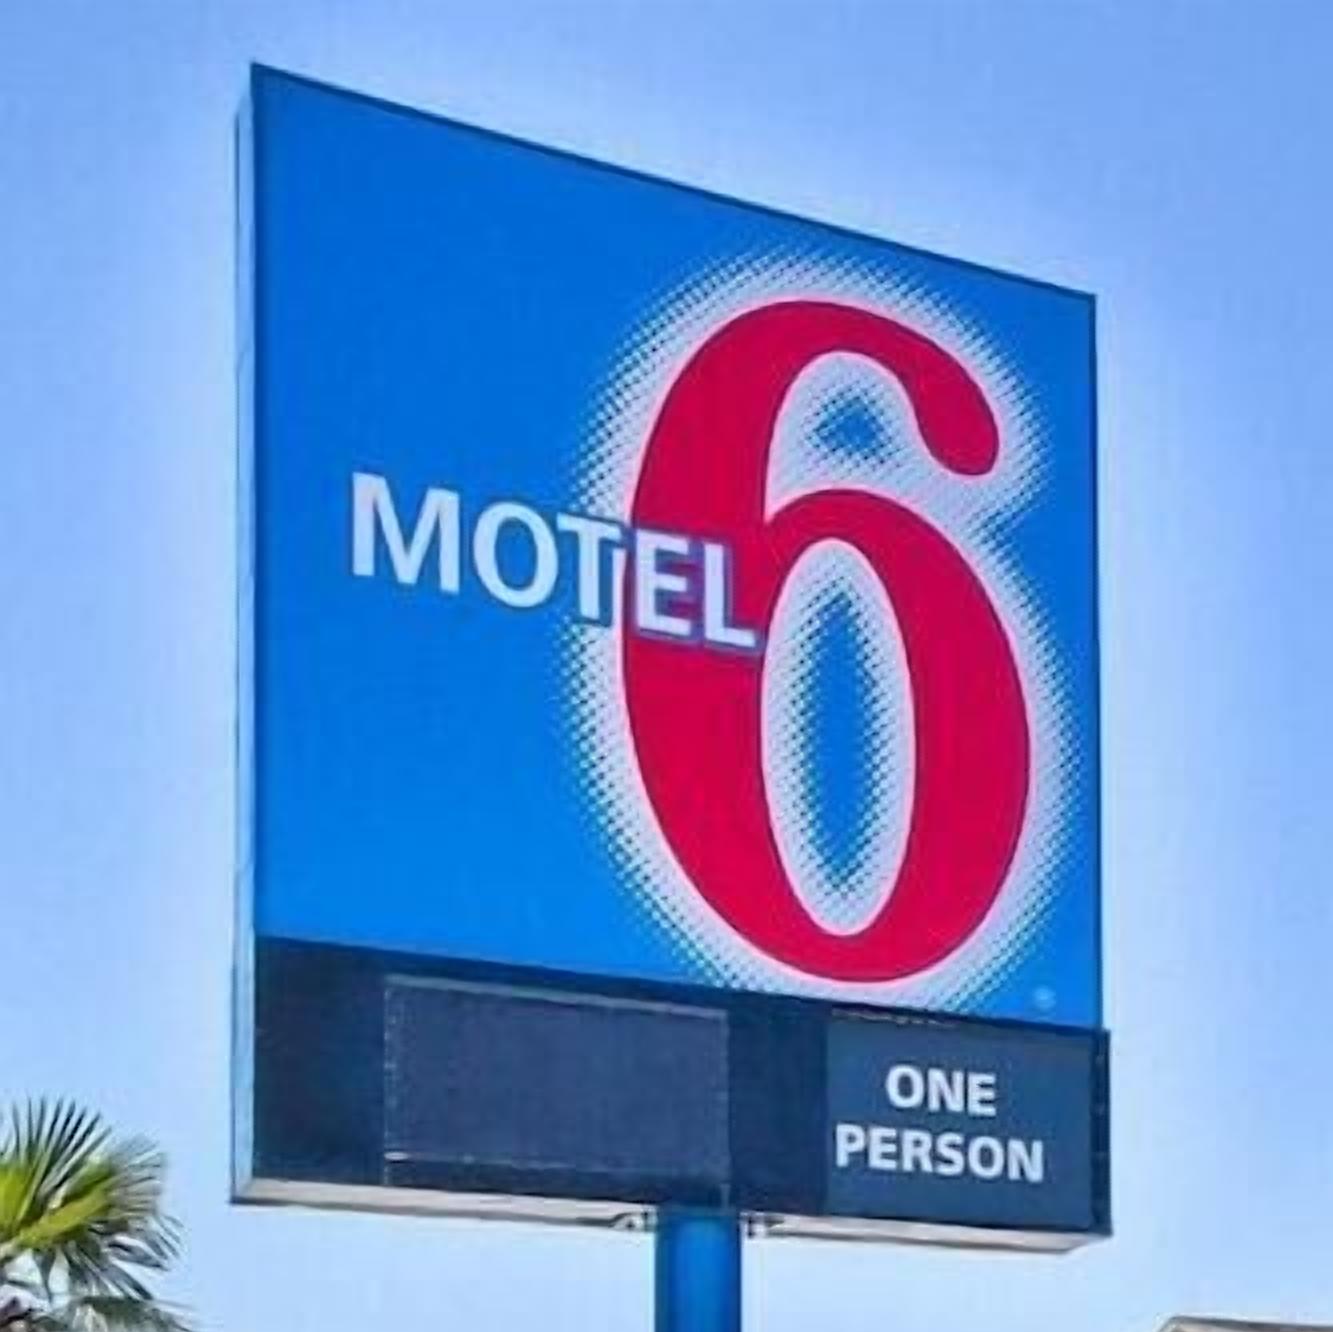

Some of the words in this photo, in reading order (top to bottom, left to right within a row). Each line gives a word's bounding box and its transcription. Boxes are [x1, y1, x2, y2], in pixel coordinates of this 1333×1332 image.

[352, 471, 757, 649] MOTEL
[622, 299, 1030, 983] 6
[886, 1064, 997, 1117] ONE
[835, 1123, 1044, 1183] PERSON
